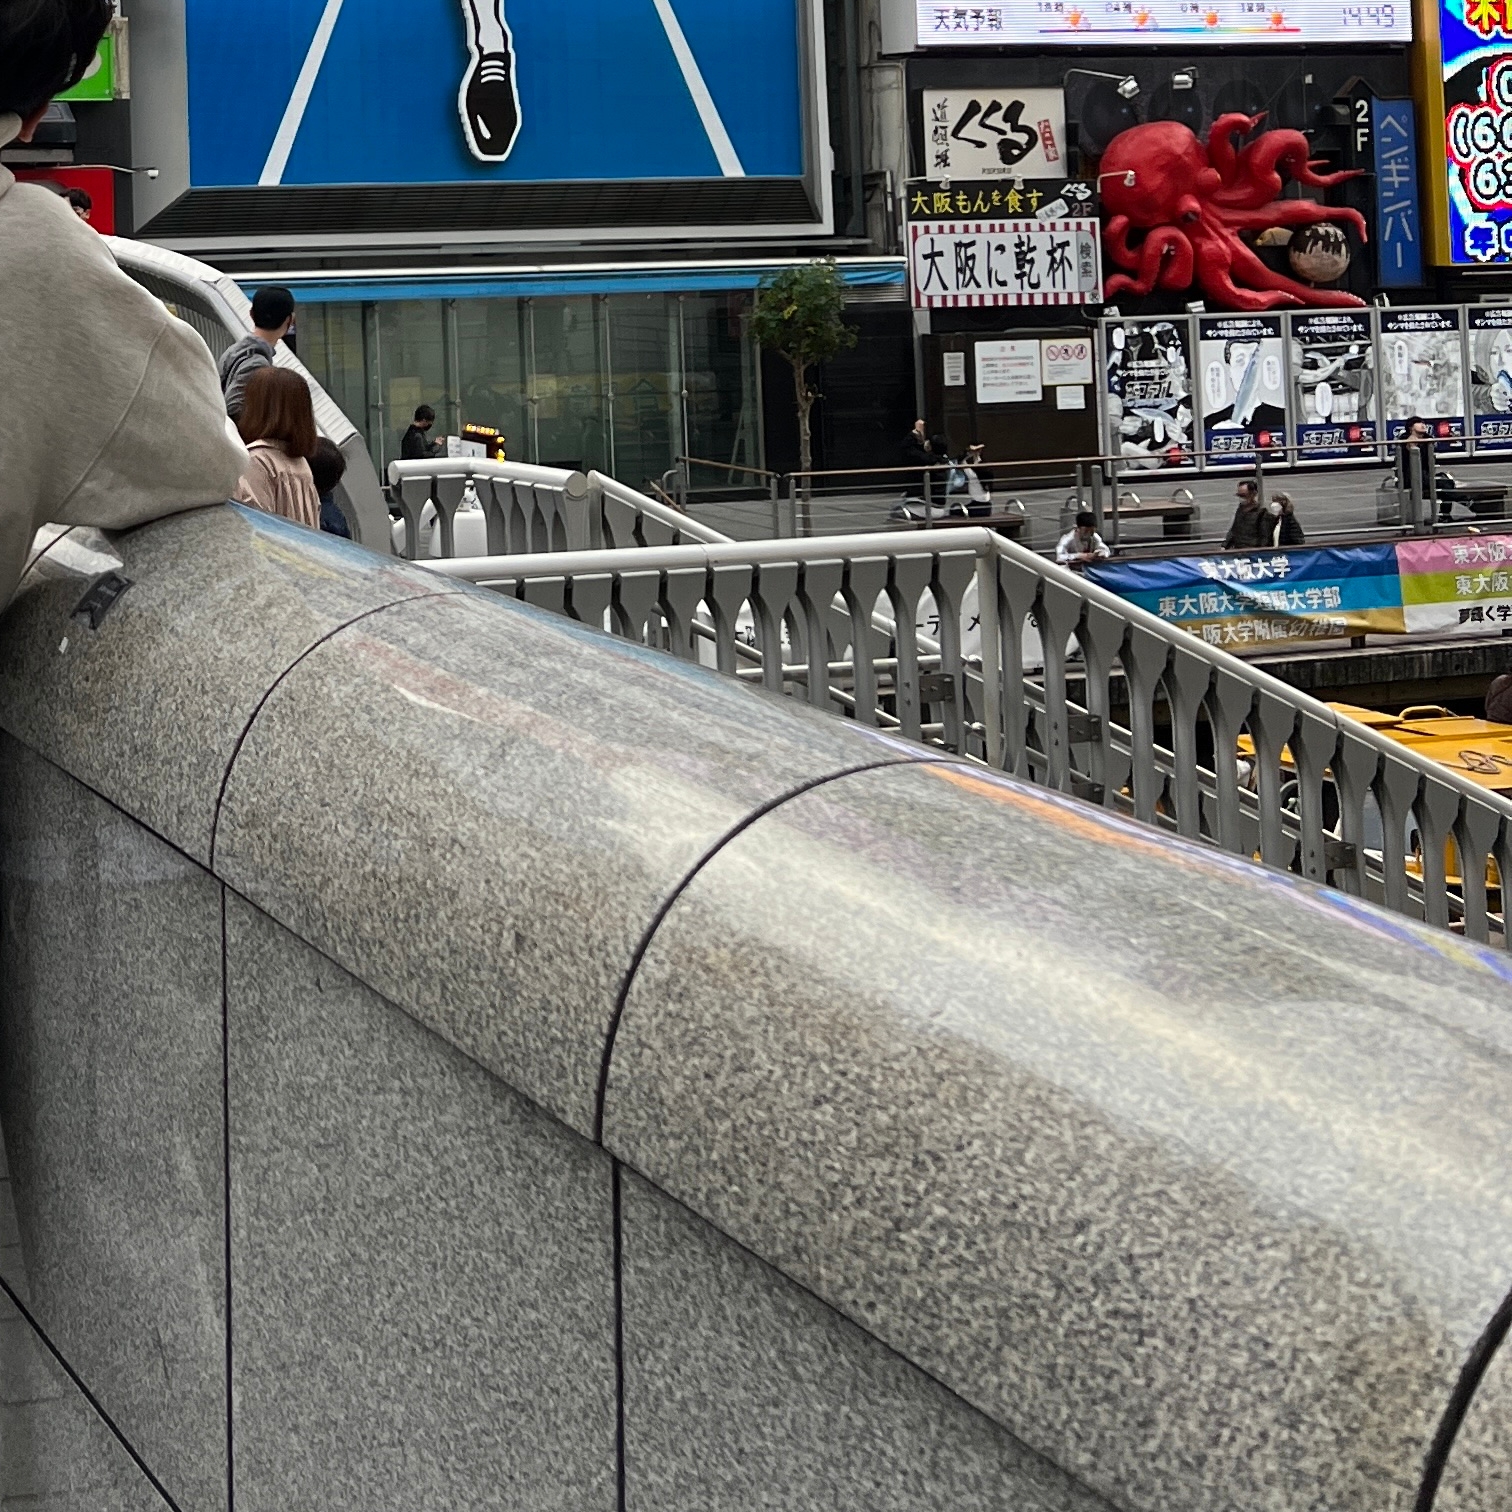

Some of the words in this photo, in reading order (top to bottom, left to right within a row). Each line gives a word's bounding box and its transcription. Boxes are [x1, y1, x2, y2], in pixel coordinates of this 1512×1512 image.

[1355, 99, 1370, 152] 2F
[1379, 114, 1414, 269] ペンギンバー
[1071, 202, 1095, 218] 2F
[922, 235, 1073, 292] 大阪に乾杯
[1452, 541, 1512, 565] 東大阪
[1199, 555, 1292, 580] 東大阪大学
[1455, 571, 1512, 596] 東大阪
